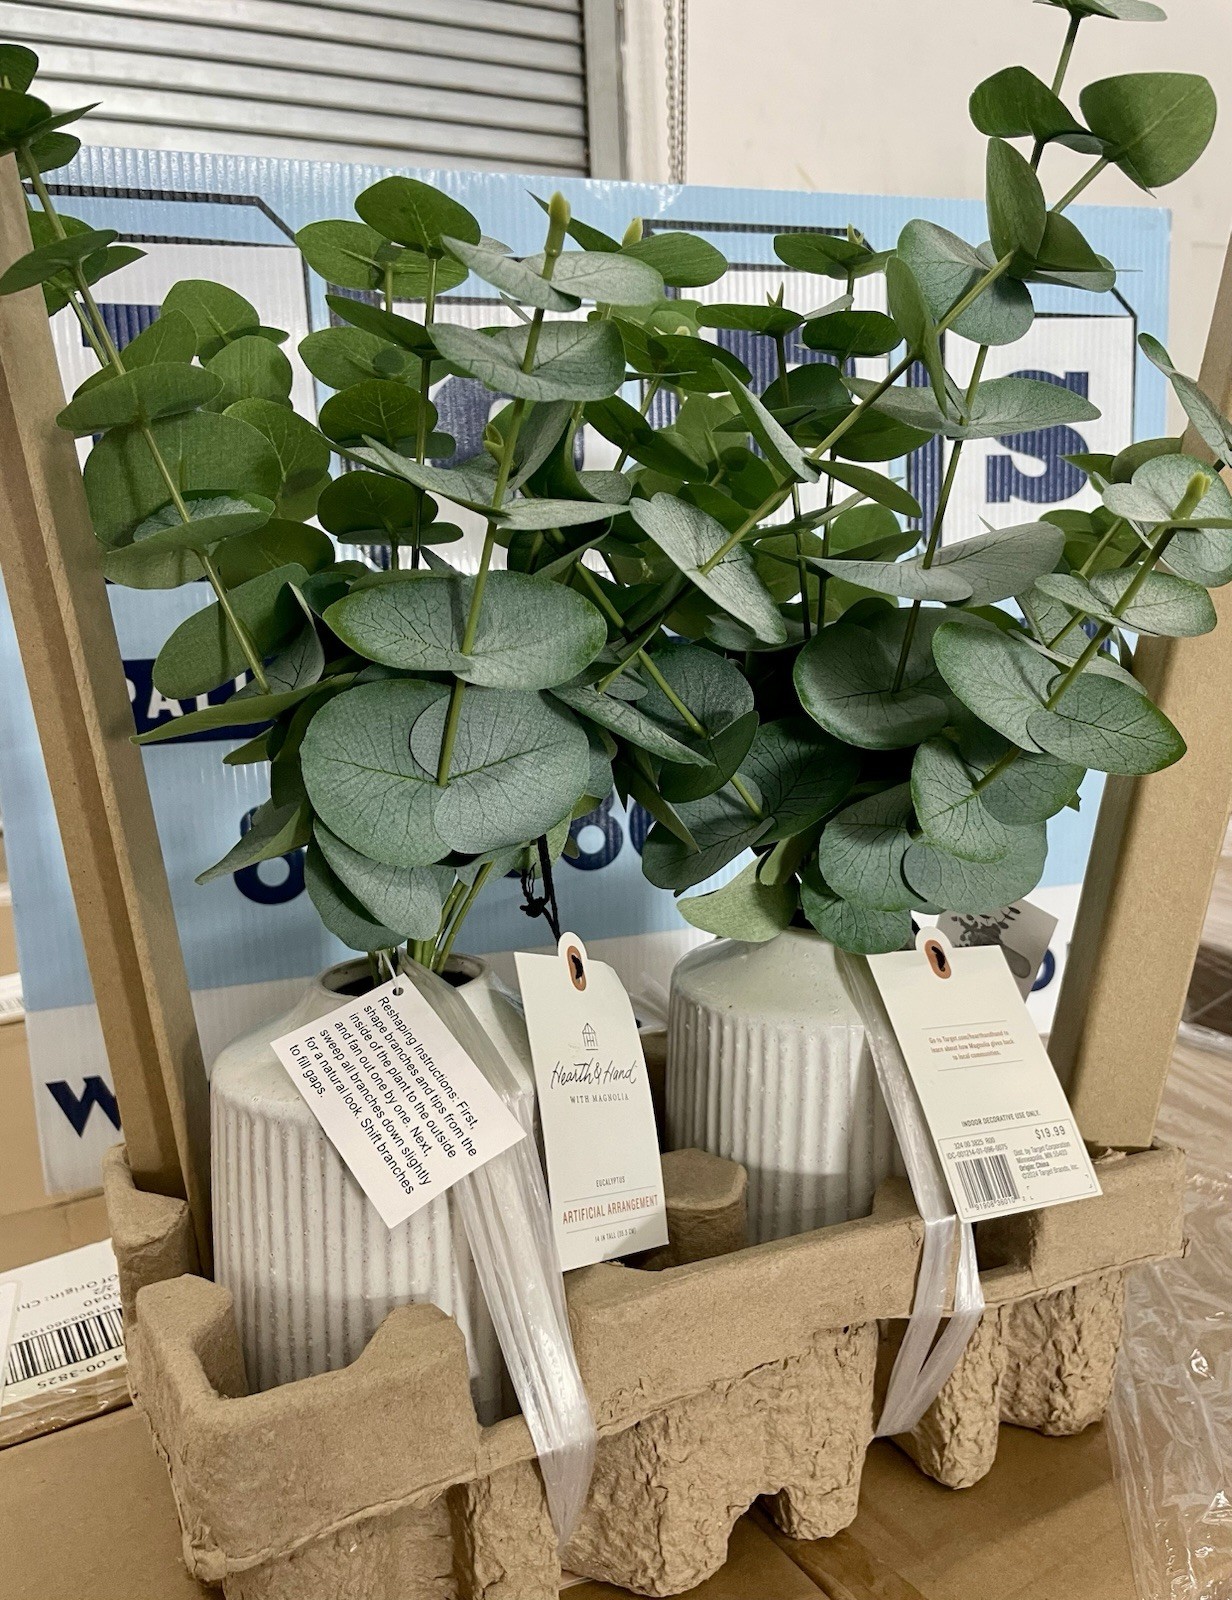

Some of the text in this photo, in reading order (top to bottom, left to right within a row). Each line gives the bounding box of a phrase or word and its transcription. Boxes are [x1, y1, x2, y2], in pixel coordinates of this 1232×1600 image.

[289, 1044, 326, 1098] to fill gaps.
[363, 1005, 477, 1156] shape branches and tips from the
[378, 996, 478, 1130] Reshaping Instructions: First,
[550, 1057, 594, 1089] Hearth
[603, 1060, 637, 1084] Hand
[334, 1022, 432, 1157] and fan out one by one. Next,
[349, 1012, 456, 1158] inside of the plant to the outside
[569, 1093, 629, 1104] WITH MAGNOLIA
[305, 1036, 414, 1194] for a natural look. Shift branches
[320, 1029, 431, 1185] sweep all branches down slightly
[960, 1110, 1040, 1127] INDOOR DECORATIVE USE ONLY.
[1035, 1125, 1066, 1140] $19.99
[595, 1175, 626, 1188] EUCALYPTUS
[562, 1194, 658, 1225] ARTIFICIAL ARRANGEMENT
[606, 1232, 616, 1240] TALL
